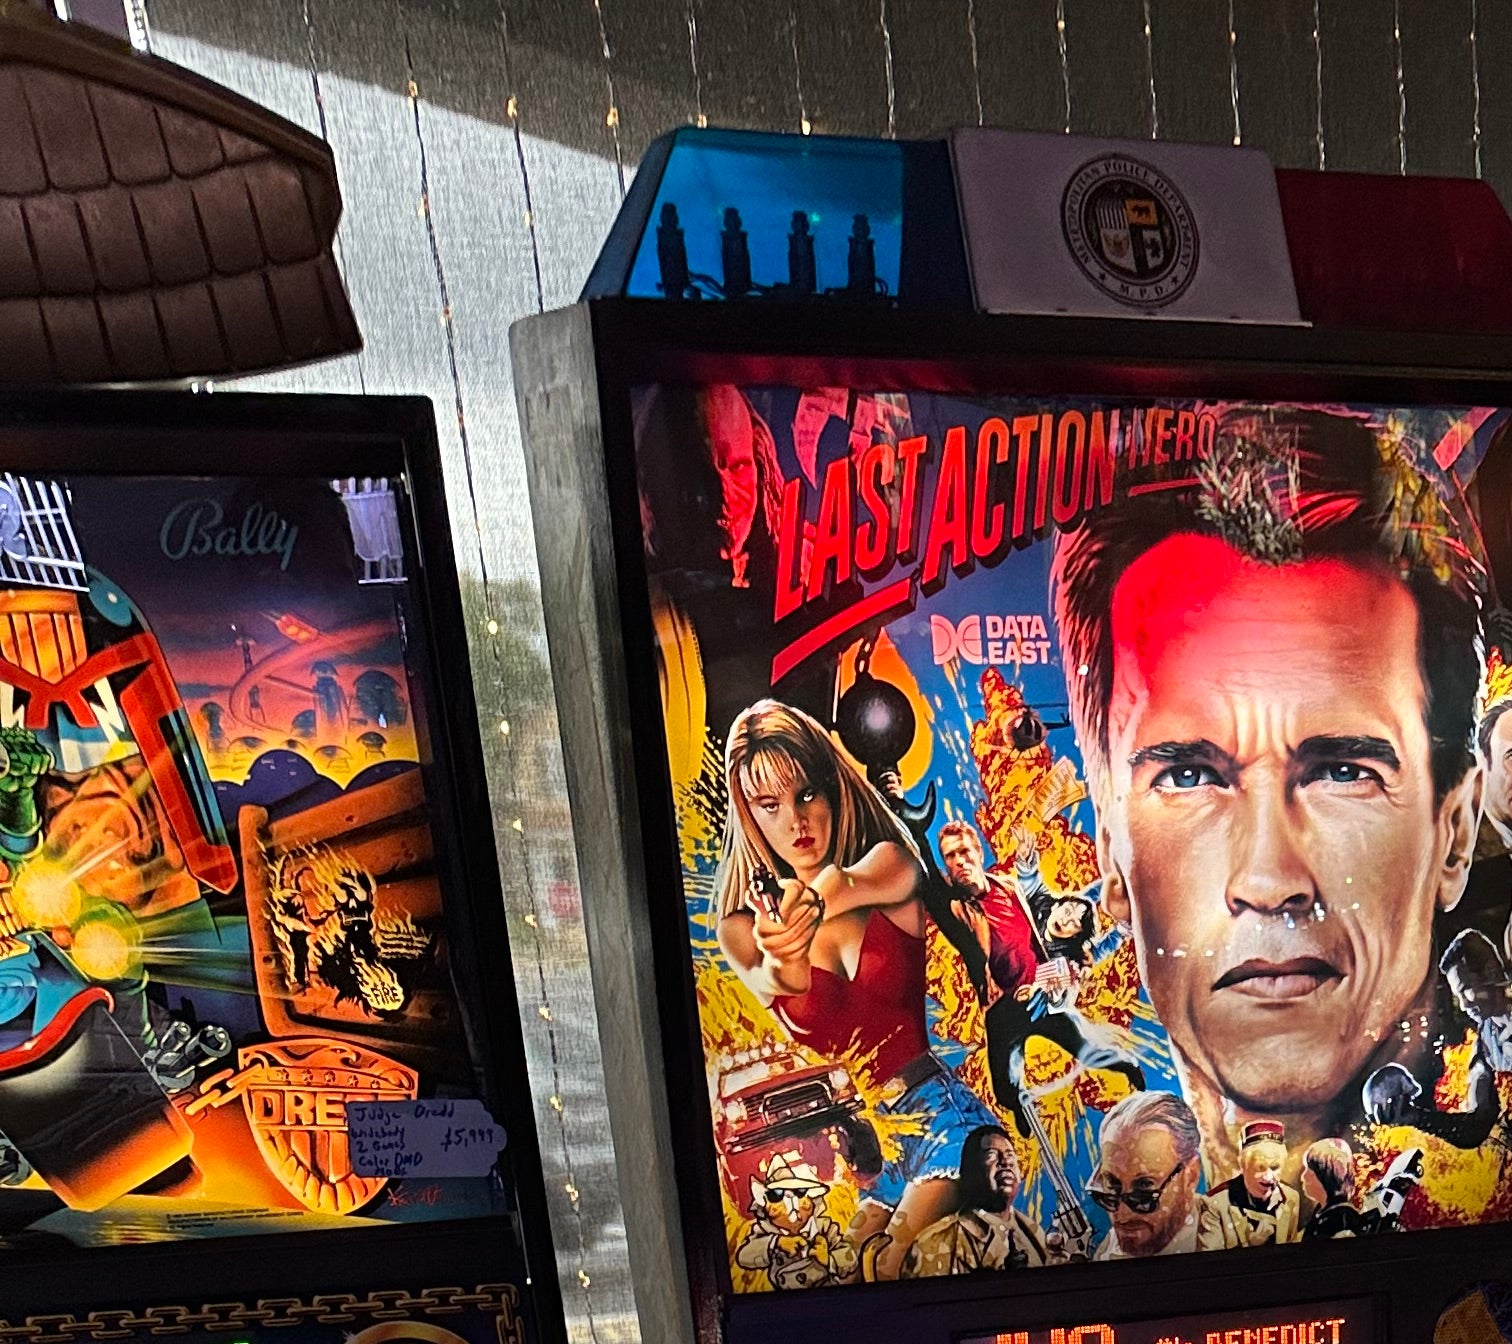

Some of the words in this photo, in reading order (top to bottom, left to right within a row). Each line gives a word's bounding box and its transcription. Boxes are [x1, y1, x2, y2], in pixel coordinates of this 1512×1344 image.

[773, 440, 926, 622] LAST
[920, 409, 1117, 584] ACTION
[1129, 408, 1218, 473] HERO
[160, 499, 299, 572] Bally
[986, 615, 1047, 641] DATA
[986, 641, 1050, 665] EAST
[355, 1106, 402, 1125] Judge
[414, 1103, 455, 1119] Dredd
